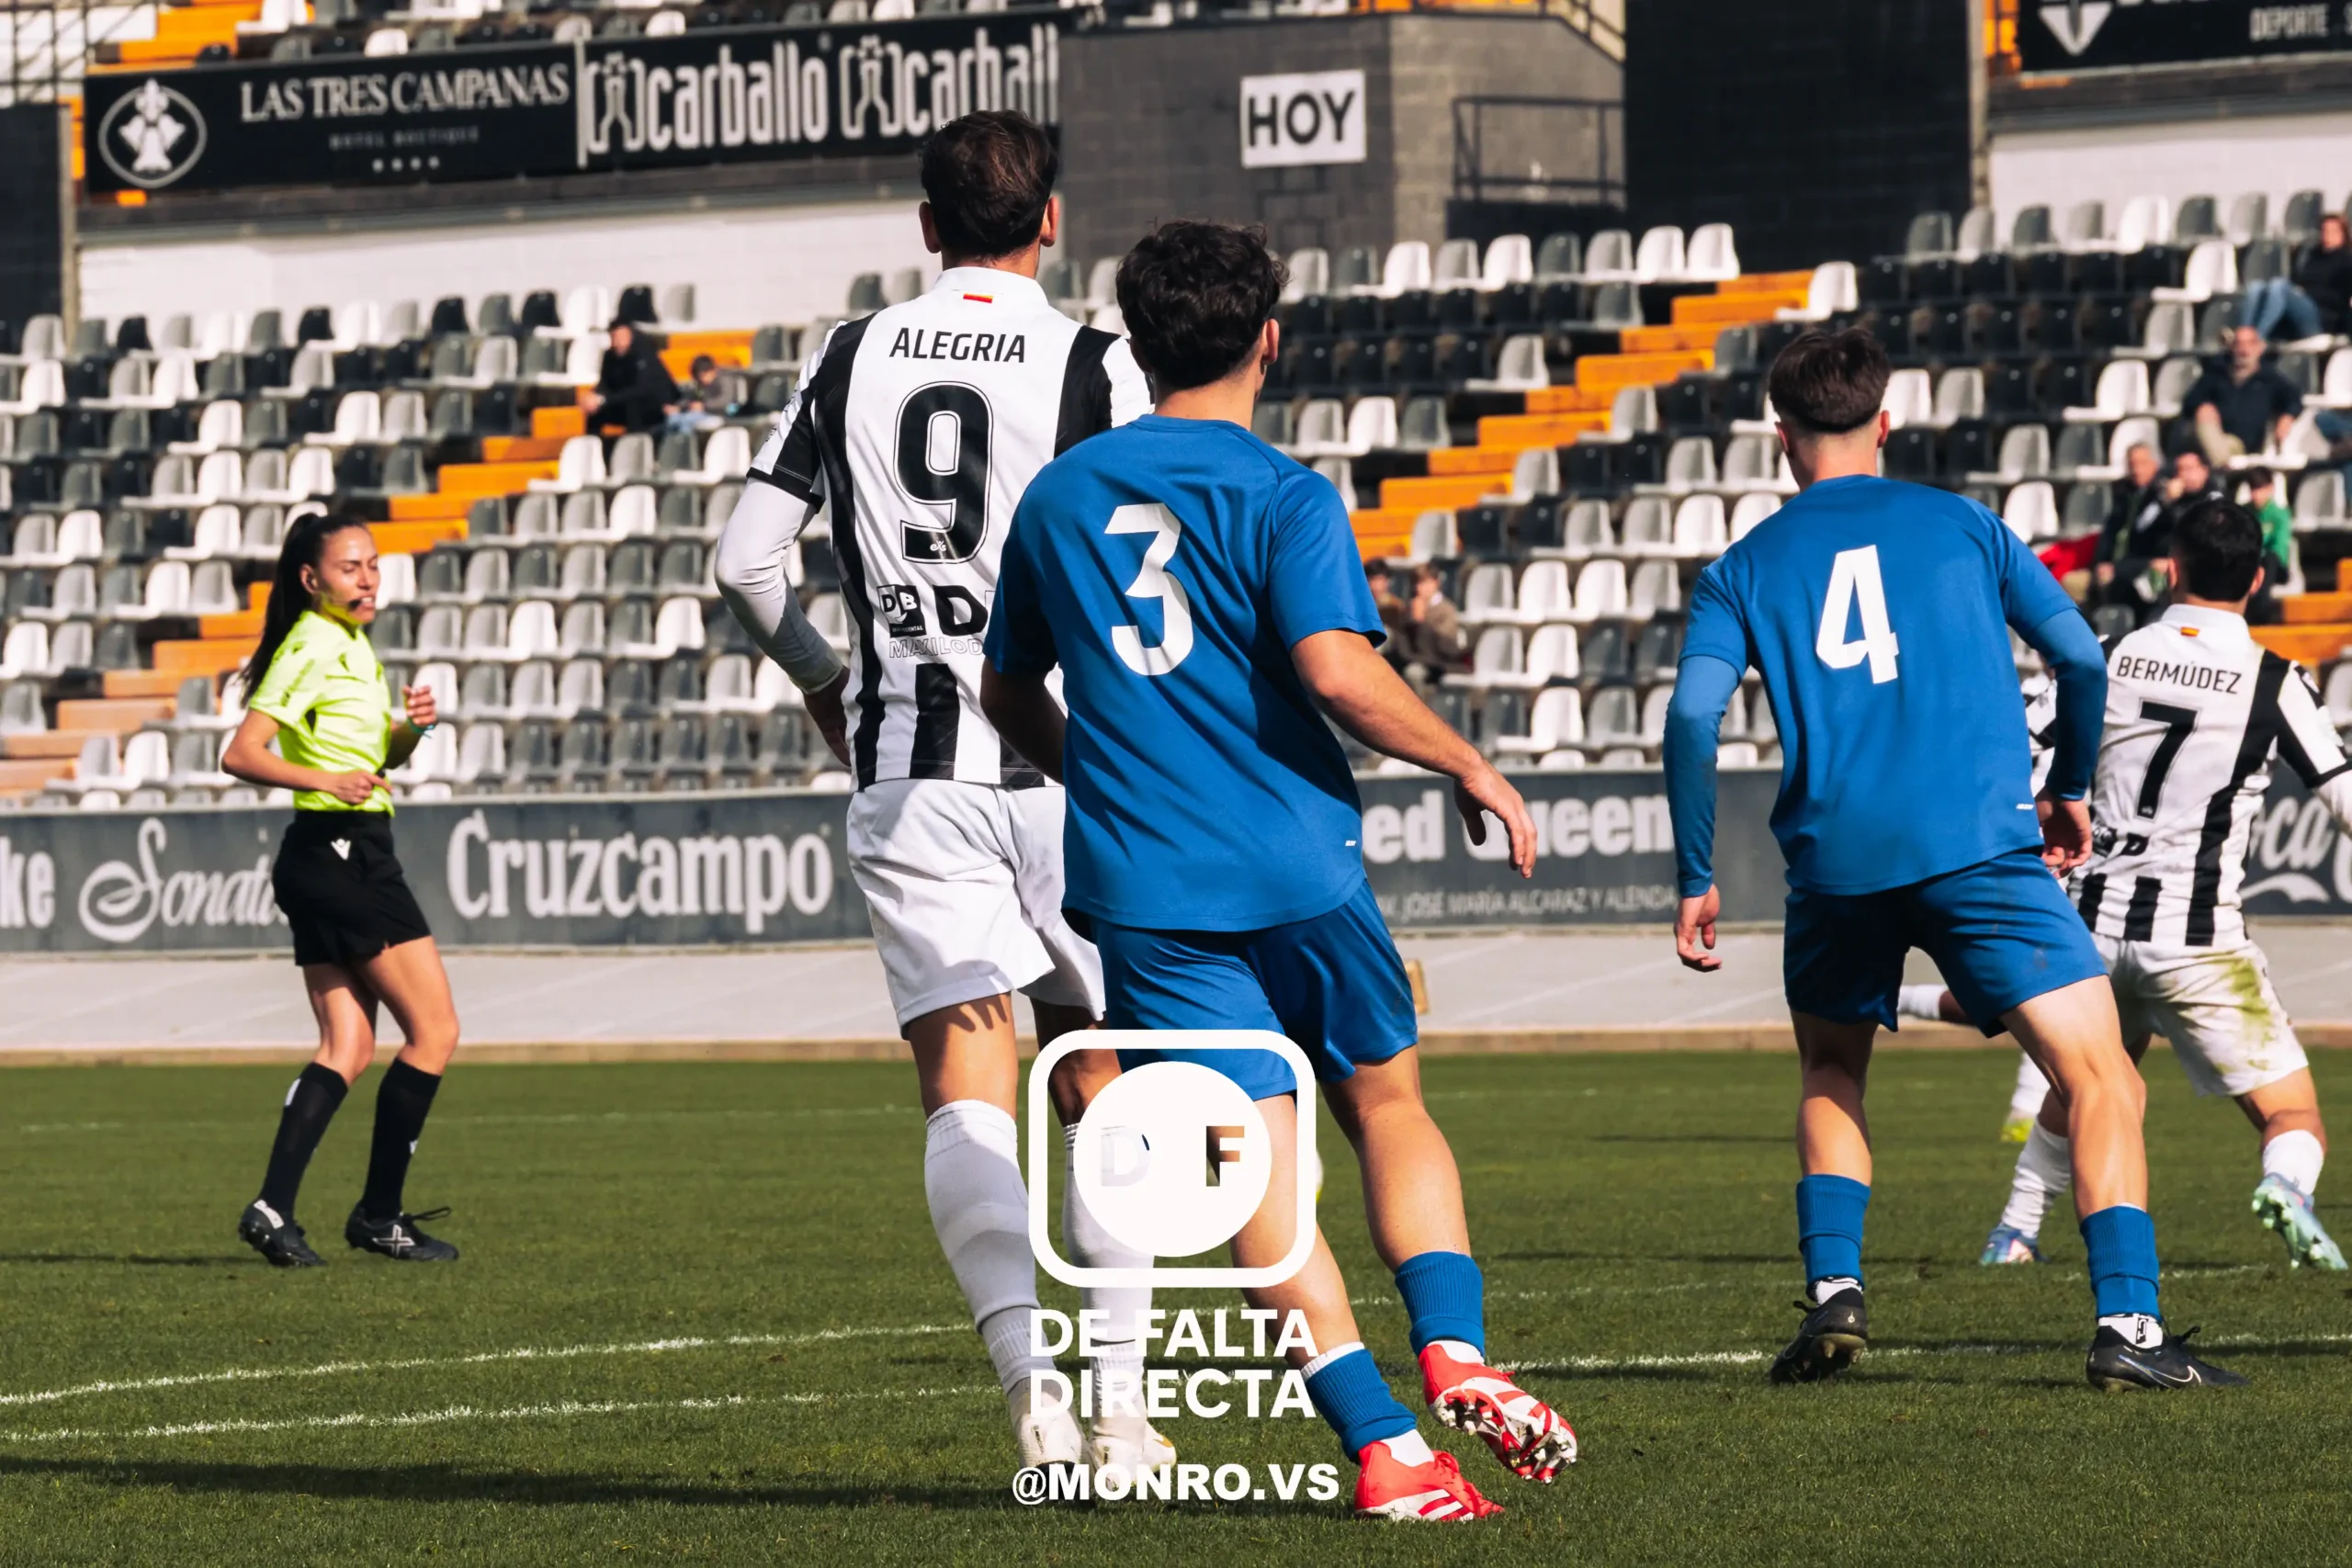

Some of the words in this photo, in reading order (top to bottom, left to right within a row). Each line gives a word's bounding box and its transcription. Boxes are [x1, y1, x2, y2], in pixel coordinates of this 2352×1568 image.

[2249, 4, 2329, 42] DEPORTE
[241, 79, 306, 122] LAS
[306, 73, 390, 118] TRES
[390, 62, 571, 114] CAMPANAS
[647, 39, 829, 152] carballo
[1247, 89, 1355, 148] HOY
[889, 327, 1025, 364] ALEGRIA
[894, 381, 994, 564] 9
[1104, 503, 1193, 676] 3
[1816, 545, 1899, 684] 4
[2116, 656, 2243, 694] BERMÚDEZ
[2135, 698, 2202, 821] 7
[447, 808, 833, 934] Cruzcampo
[1363, 789, 1445, 863] ed
[0, 836, 55, 929] ke
